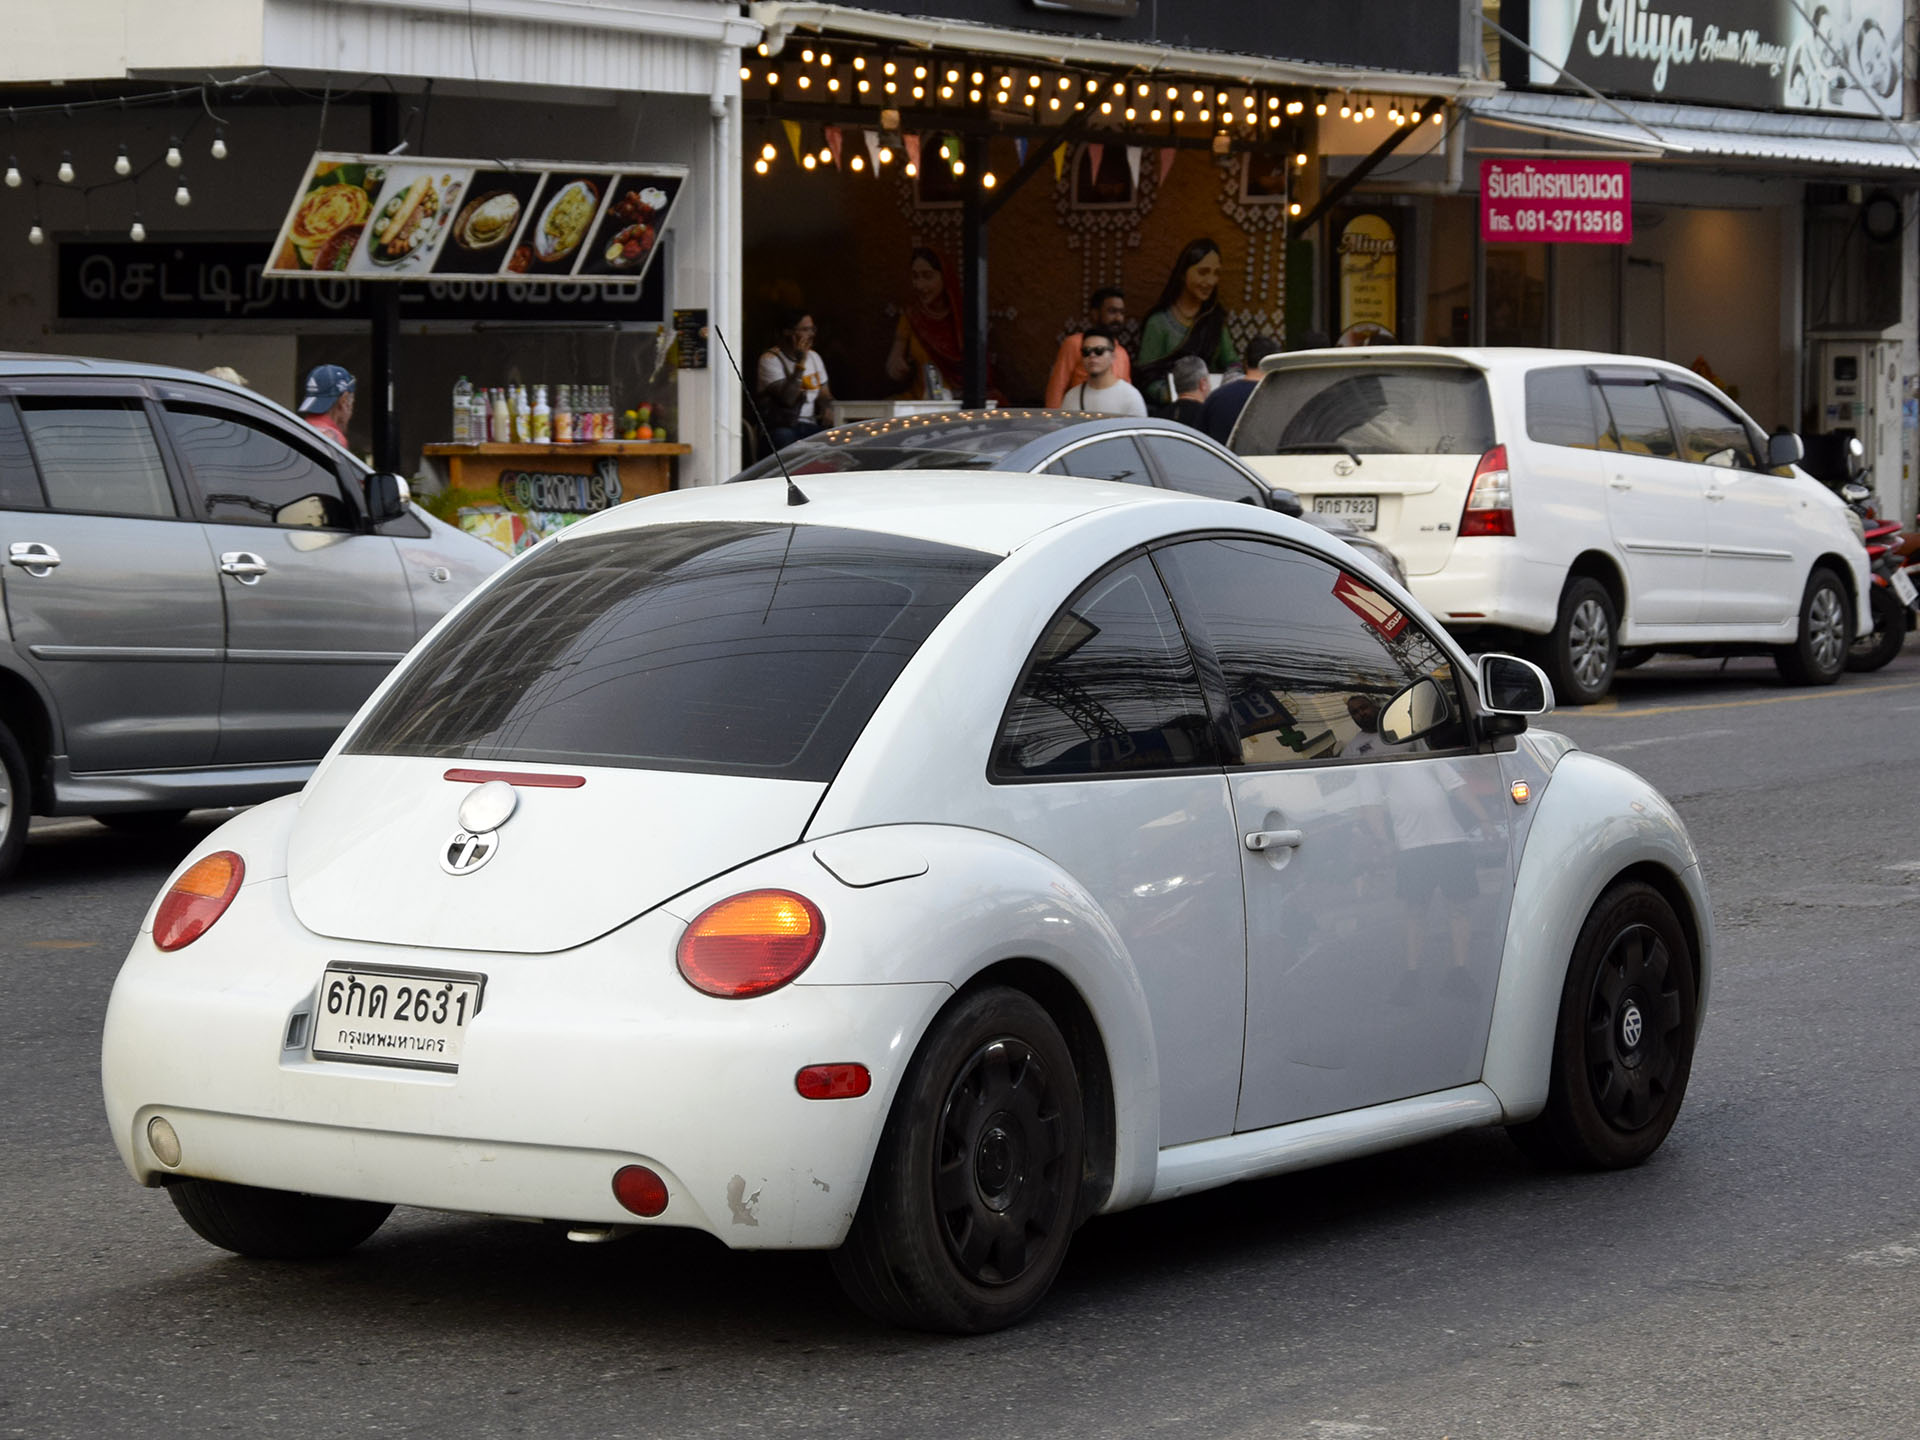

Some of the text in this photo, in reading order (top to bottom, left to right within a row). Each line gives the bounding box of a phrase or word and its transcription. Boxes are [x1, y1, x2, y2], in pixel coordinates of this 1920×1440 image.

[1587, 0, 1787, 91] Aliya Health Massage
[1488, 165, 1623, 199] รับสมัครหมอนวด
[1489, 208, 1623, 233] โทร. 081-3713518
[1337, 233, 1397, 262] Aliya
[1345, 500, 1374, 514] 7923
[327, 980, 468, 1027] 6กด 2631
[337, 1029, 446, 1053] กรุงเทพมหานคร
